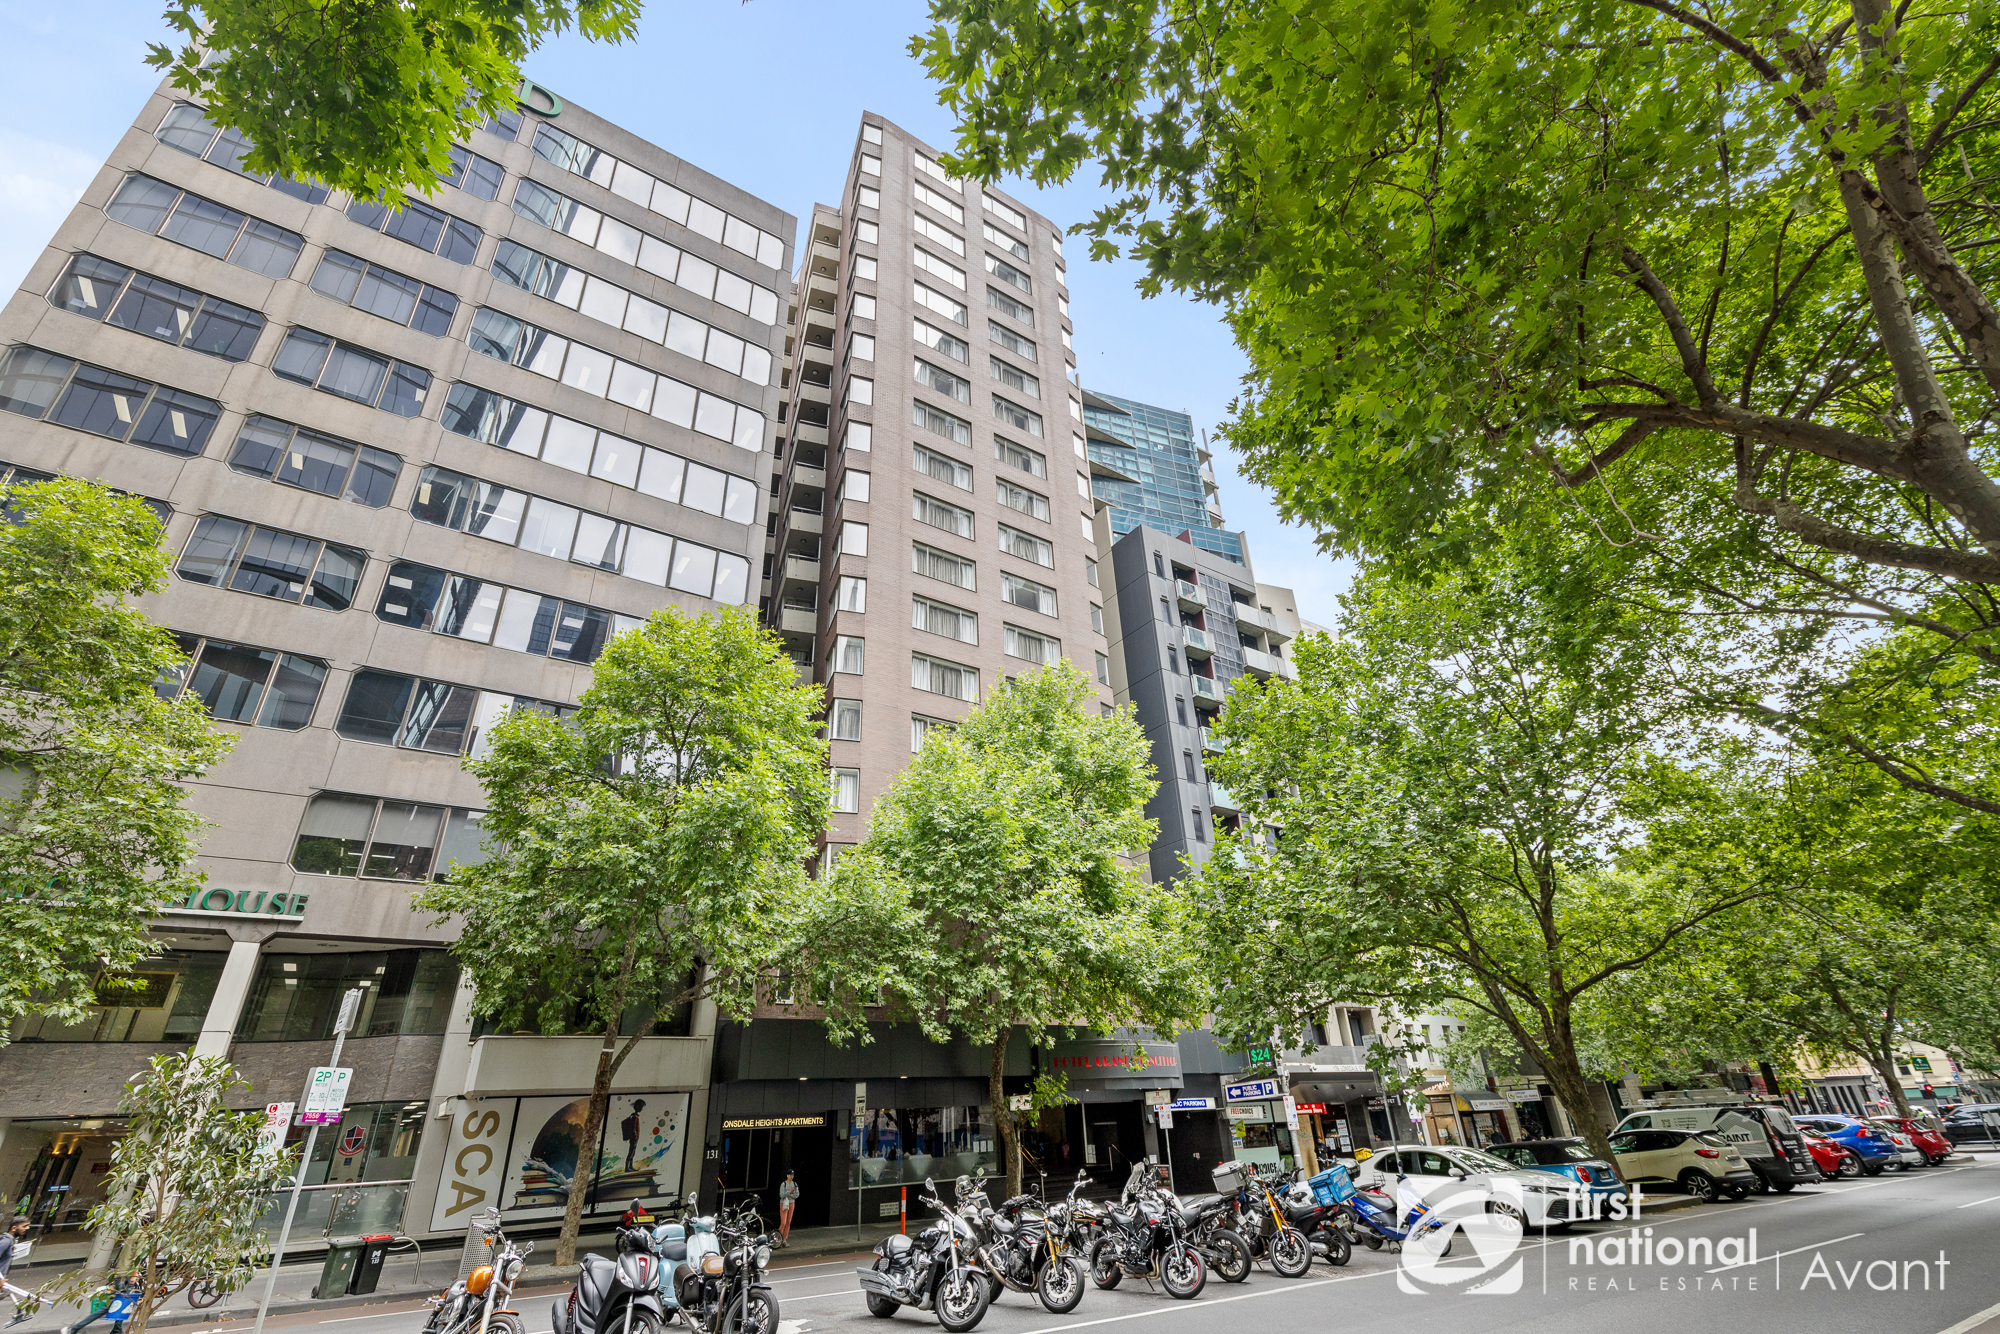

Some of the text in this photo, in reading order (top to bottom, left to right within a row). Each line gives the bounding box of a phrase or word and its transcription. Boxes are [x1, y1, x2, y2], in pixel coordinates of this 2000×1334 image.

[163, 886, 310, 916] HOUSE
[1250, 1046, 1271, 1063] $24
[1053, 1056, 1093, 1068] HOTEL
[315, 1071, 332, 1082] 2P
[337, 1072, 346, 1083] P
[1242, 1089, 1262, 1097] PARKING
[1265, 1083, 1272, 1094] P
[722, 1116, 824, 1129] ONSDALE HEIGHTS APARTMENTS
[706, 1149, 719, 1159] 131
[444, 1110, 500, 1218] SCA
